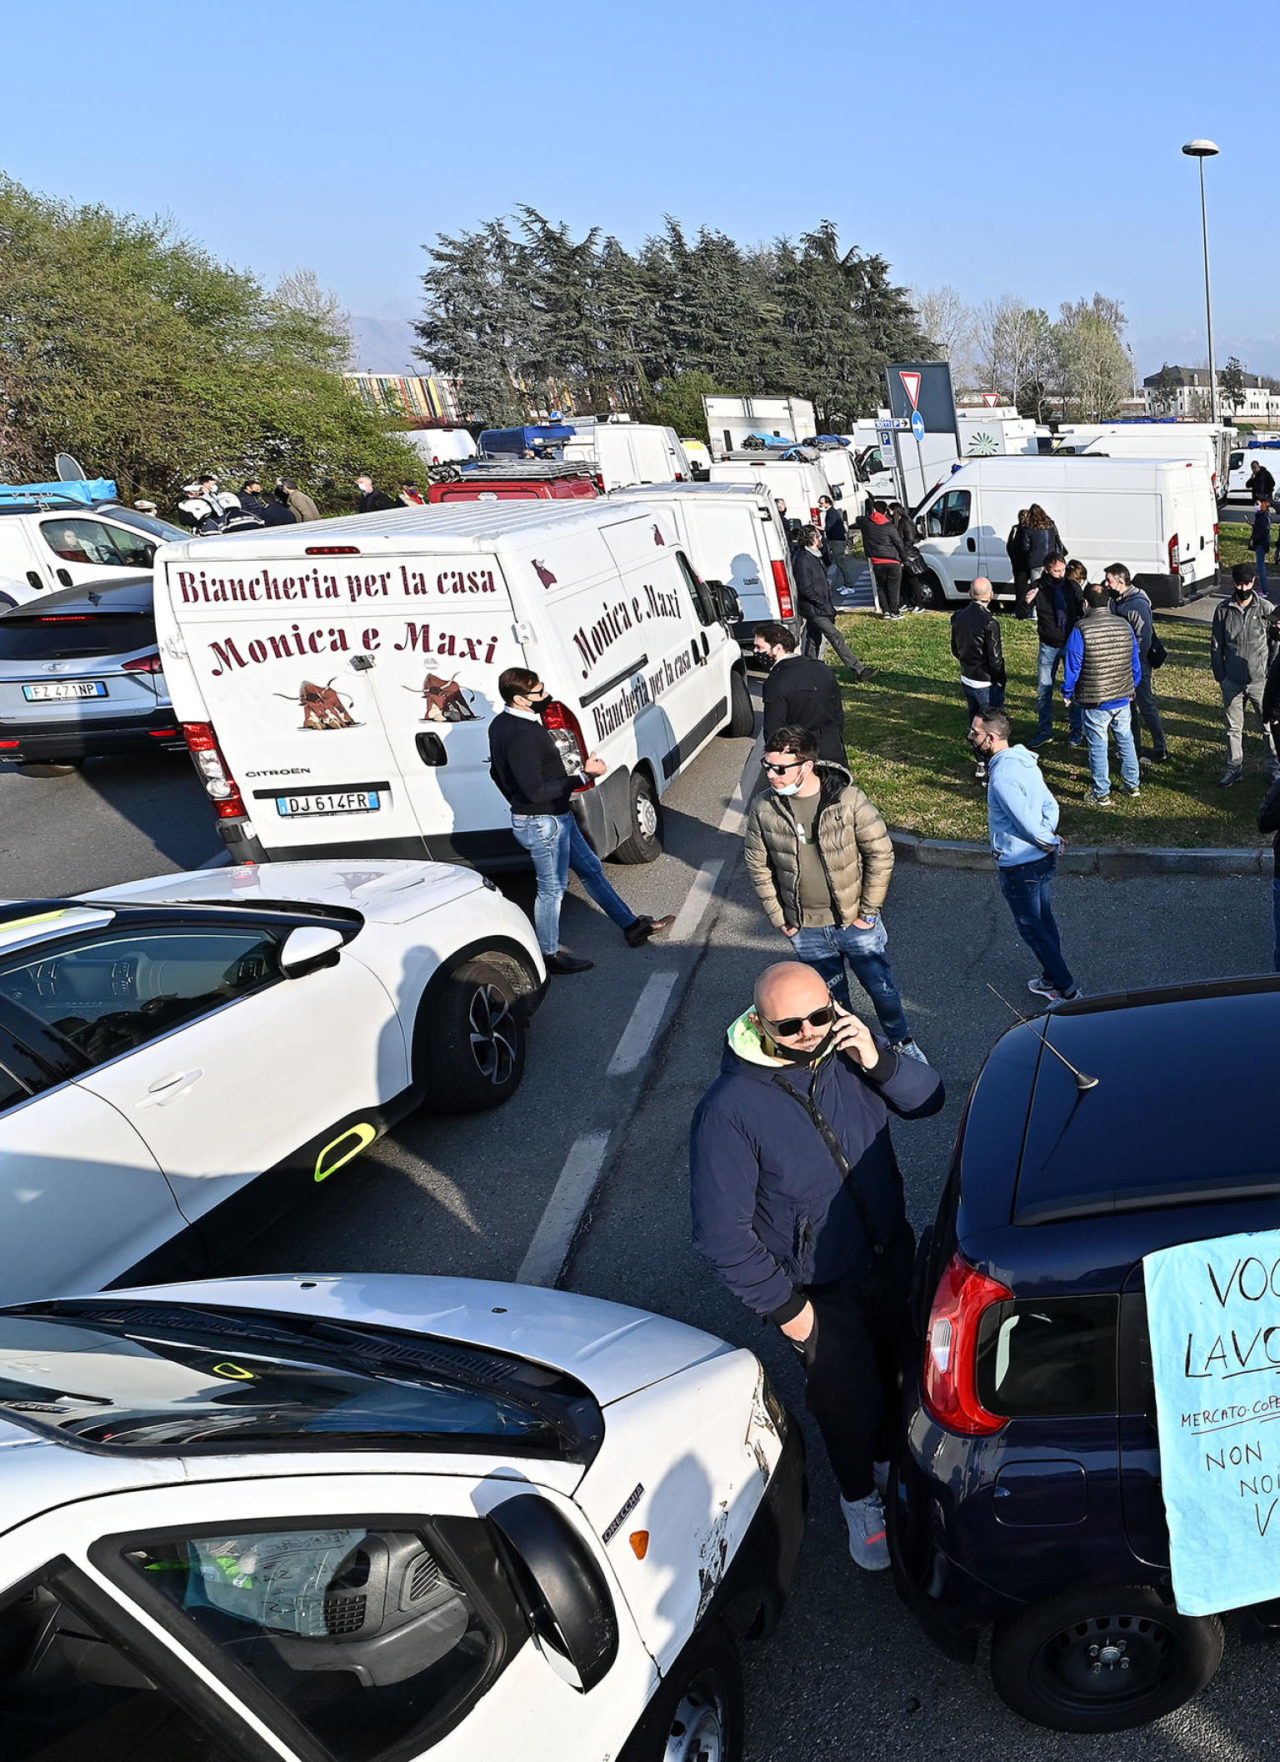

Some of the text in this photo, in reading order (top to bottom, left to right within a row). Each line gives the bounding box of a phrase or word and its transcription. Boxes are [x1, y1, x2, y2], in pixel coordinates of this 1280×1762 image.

[177, 565, 496, 603] Biancheria per la casa
[208, 622, 498, 676] Monica e Maxi
[572, 585, 681, 679] Monica e Maxi
[592, 650, 691, 742] Biancheria per la casa
[1206, 1441, 1262, 1471] NON
